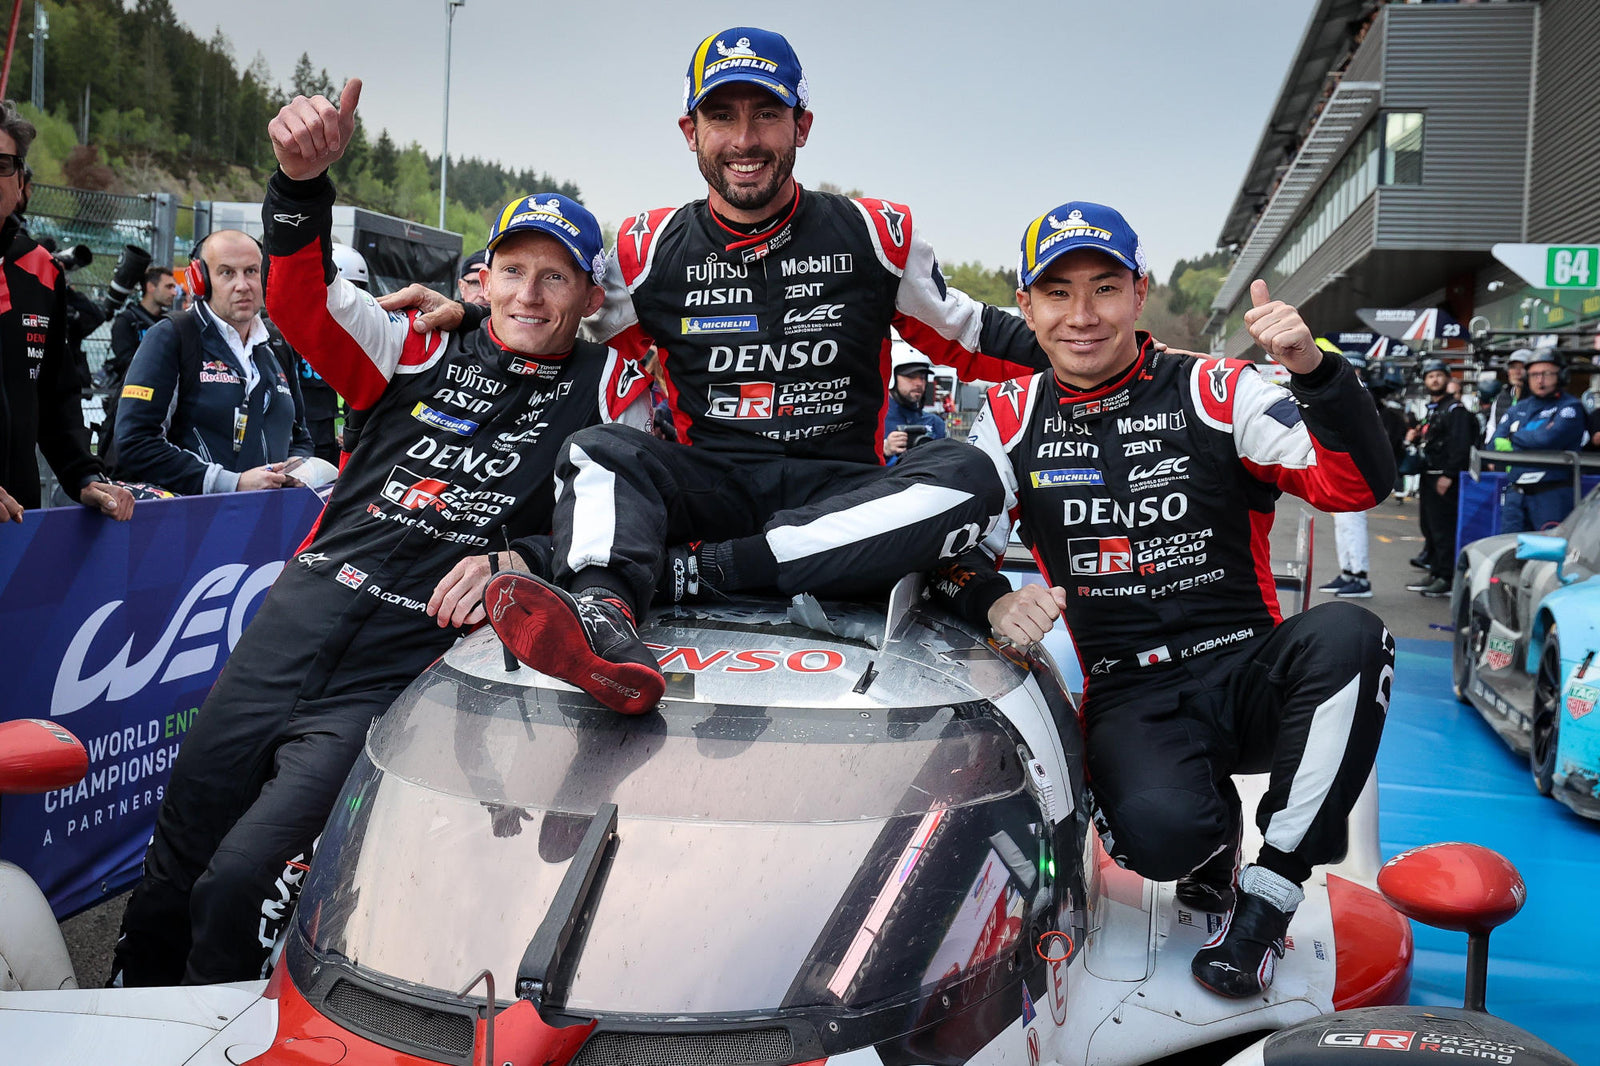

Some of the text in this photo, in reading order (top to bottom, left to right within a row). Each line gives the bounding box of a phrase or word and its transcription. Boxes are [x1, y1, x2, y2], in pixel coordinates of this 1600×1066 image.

[704, 59, 777, 80] MICHELIN
[509, 214, 579, 237] MICHELIN
[1039, 228, 1112, 254] MICHELIN
[686, 252, 749, 285] FUJITSU
[781, 255, 849, 277] Mobil 1
[1553, 249, 1590, 285] 64
[684, 287, 753, 306] AISIN
[784, 283, 823, 299] ZENT
[702, 319, 751, 329] MICHELIN
[783, 303, 845, 324] WEC
[1442, 323, 1460, 337] 23
[27, 346, 44, 359] Mob
[707, 340, 838, 373] DENSO
[1392, 344, 1409, 357] 22
[446, 363, 507, 396] FUJITSU
[510, 363, 537, 375] GR
[779, 376, 851, 395] TOYOTA
[1102, 389, 1130, 402] TOYOTA
[711, 396, 773, 417] GR
[779, 391, 847, 406] GAZOO
[777, 402, 844, 418] Racing
[1117, 412, 1184, 435] Mobil 1
[406, 435, 521, 482] DENSO
[1037, 441, 1100, 459] AISIN
[1122, 439, 1163, 457] ZENT
[1053, 472, 1101, 482] MICHELIN
[1128, 455, 1190, 481] WEC
[1158, 474, 1190, 484] ENDURANCE
[429, 498, 491, 527] Racing
[439, 492, 502, 515] GAZOO
[1063, 491, 1187, 528] DENSO
[1134, 528, 1213, 549] TOYOTA
[1071, 551, 1132, 574] GR
[1138, 540, 1206, 563] GAZOO
[1139, 552, 1207, 576] Racing
[1077, 568, 1225, 599] RACING HYBRID
[380, 592, 427, 613] CONWA
[50, 560, 286, 716] WEC
[1181, 627, 1254, 659] K. KOBAYASHI
[642, 641, 847, 674] NSO
[88, 719, 159, 762] WORLD
[44, 743, 180, 814] CHAMPIONSH
[43, 785, 165, 846] A PARTNERS
[1323, 1033, 1411, 1050] GR
[1419, 1043, 1514, 1065] Racing
